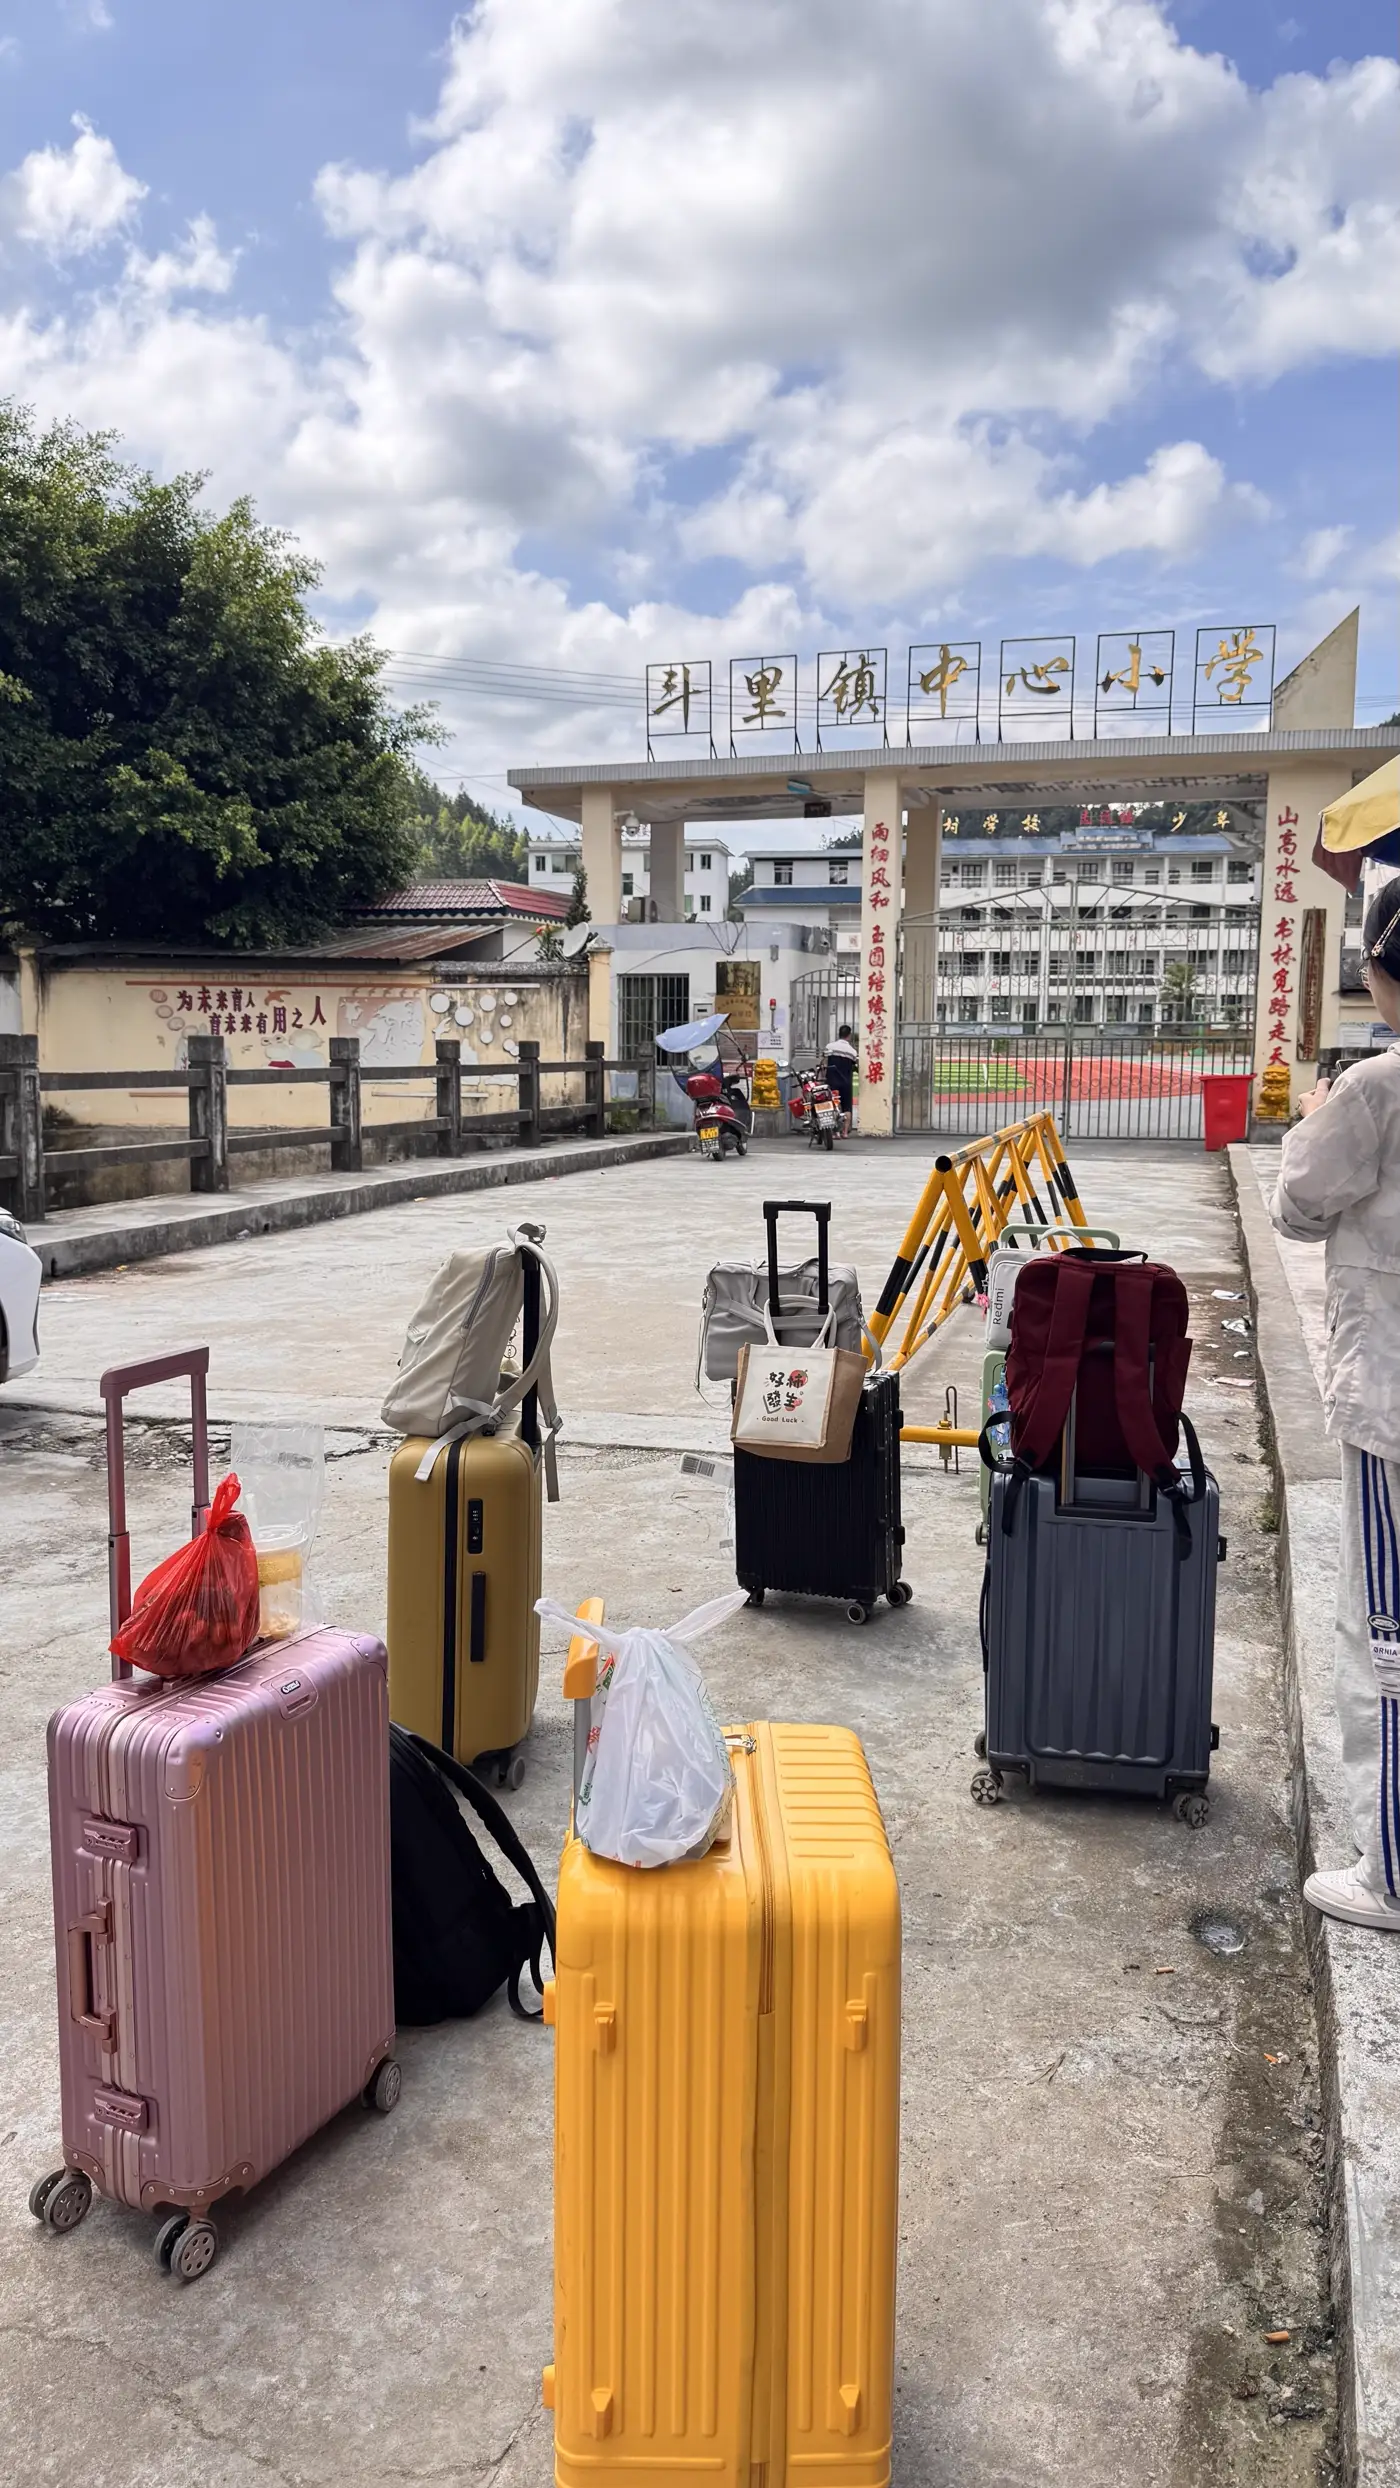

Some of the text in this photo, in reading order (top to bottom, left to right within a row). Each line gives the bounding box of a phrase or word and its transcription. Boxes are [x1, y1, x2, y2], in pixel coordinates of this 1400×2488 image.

[651, 627, 1264, 733] 斗里镇中心小学
[1274, 805, 1301, 904] 山高水远
[177, 986, 256, 1014] 为未来育人
[208, 995, 328, 1035] 育未来有用之人
[993, 1287, 1005, 1325] Redmi
[766, 1390, 798, 1408] 發生
[769, 1371, 804, 1389] 好柿
